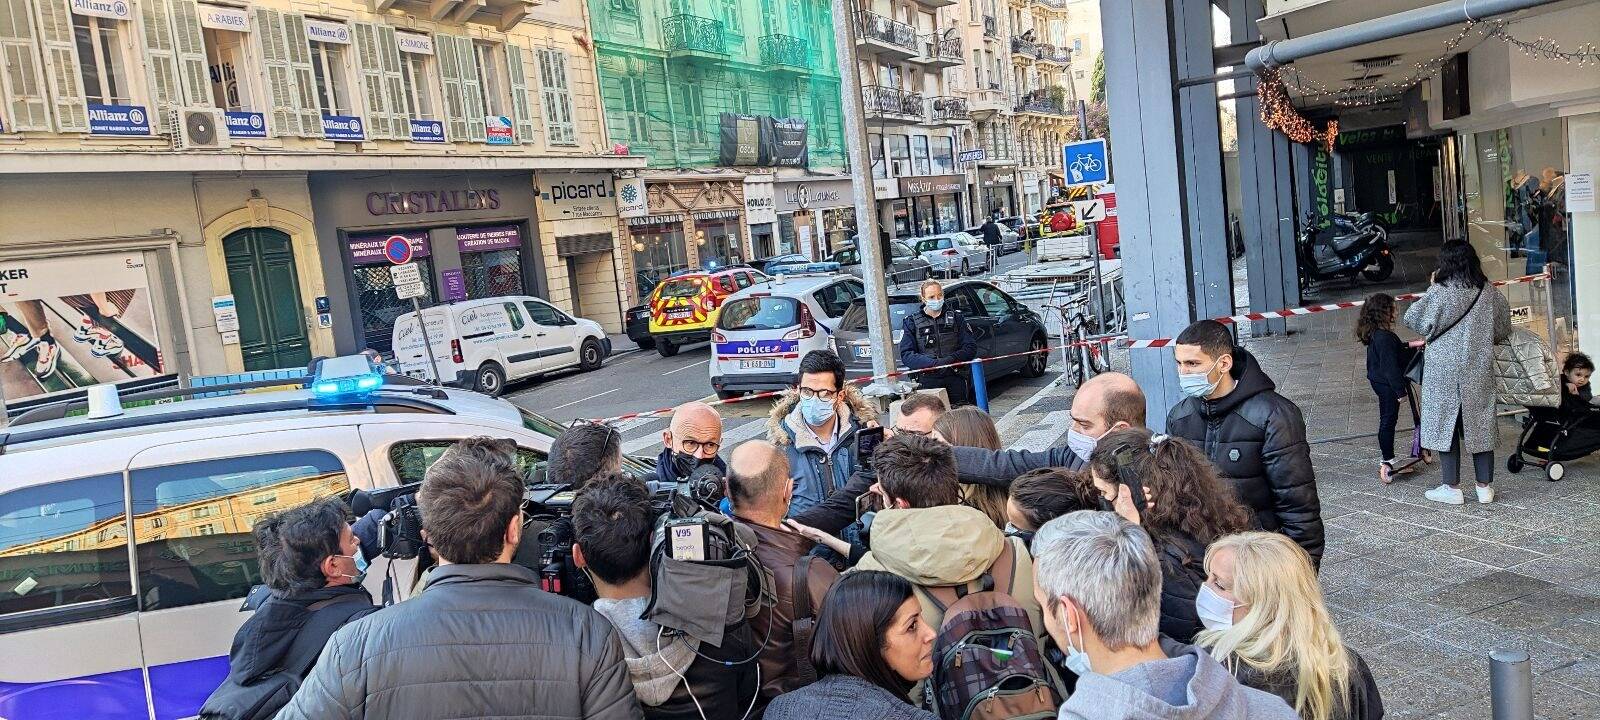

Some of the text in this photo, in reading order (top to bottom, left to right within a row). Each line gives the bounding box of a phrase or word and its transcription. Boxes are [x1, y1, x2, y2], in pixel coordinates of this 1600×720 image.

[74, 0, 112, 12] Allianz
[310, 26, 337, 38] Allianz
[89, 109, 129, 122] Allianz
[551, 180, 606, 204] picard
[619, 203, 643, 213] picard
[461, 310, 479, 326] Ciel
[737, 346, 771, 354] POLICE
[675, 528, 692, 538] V95
